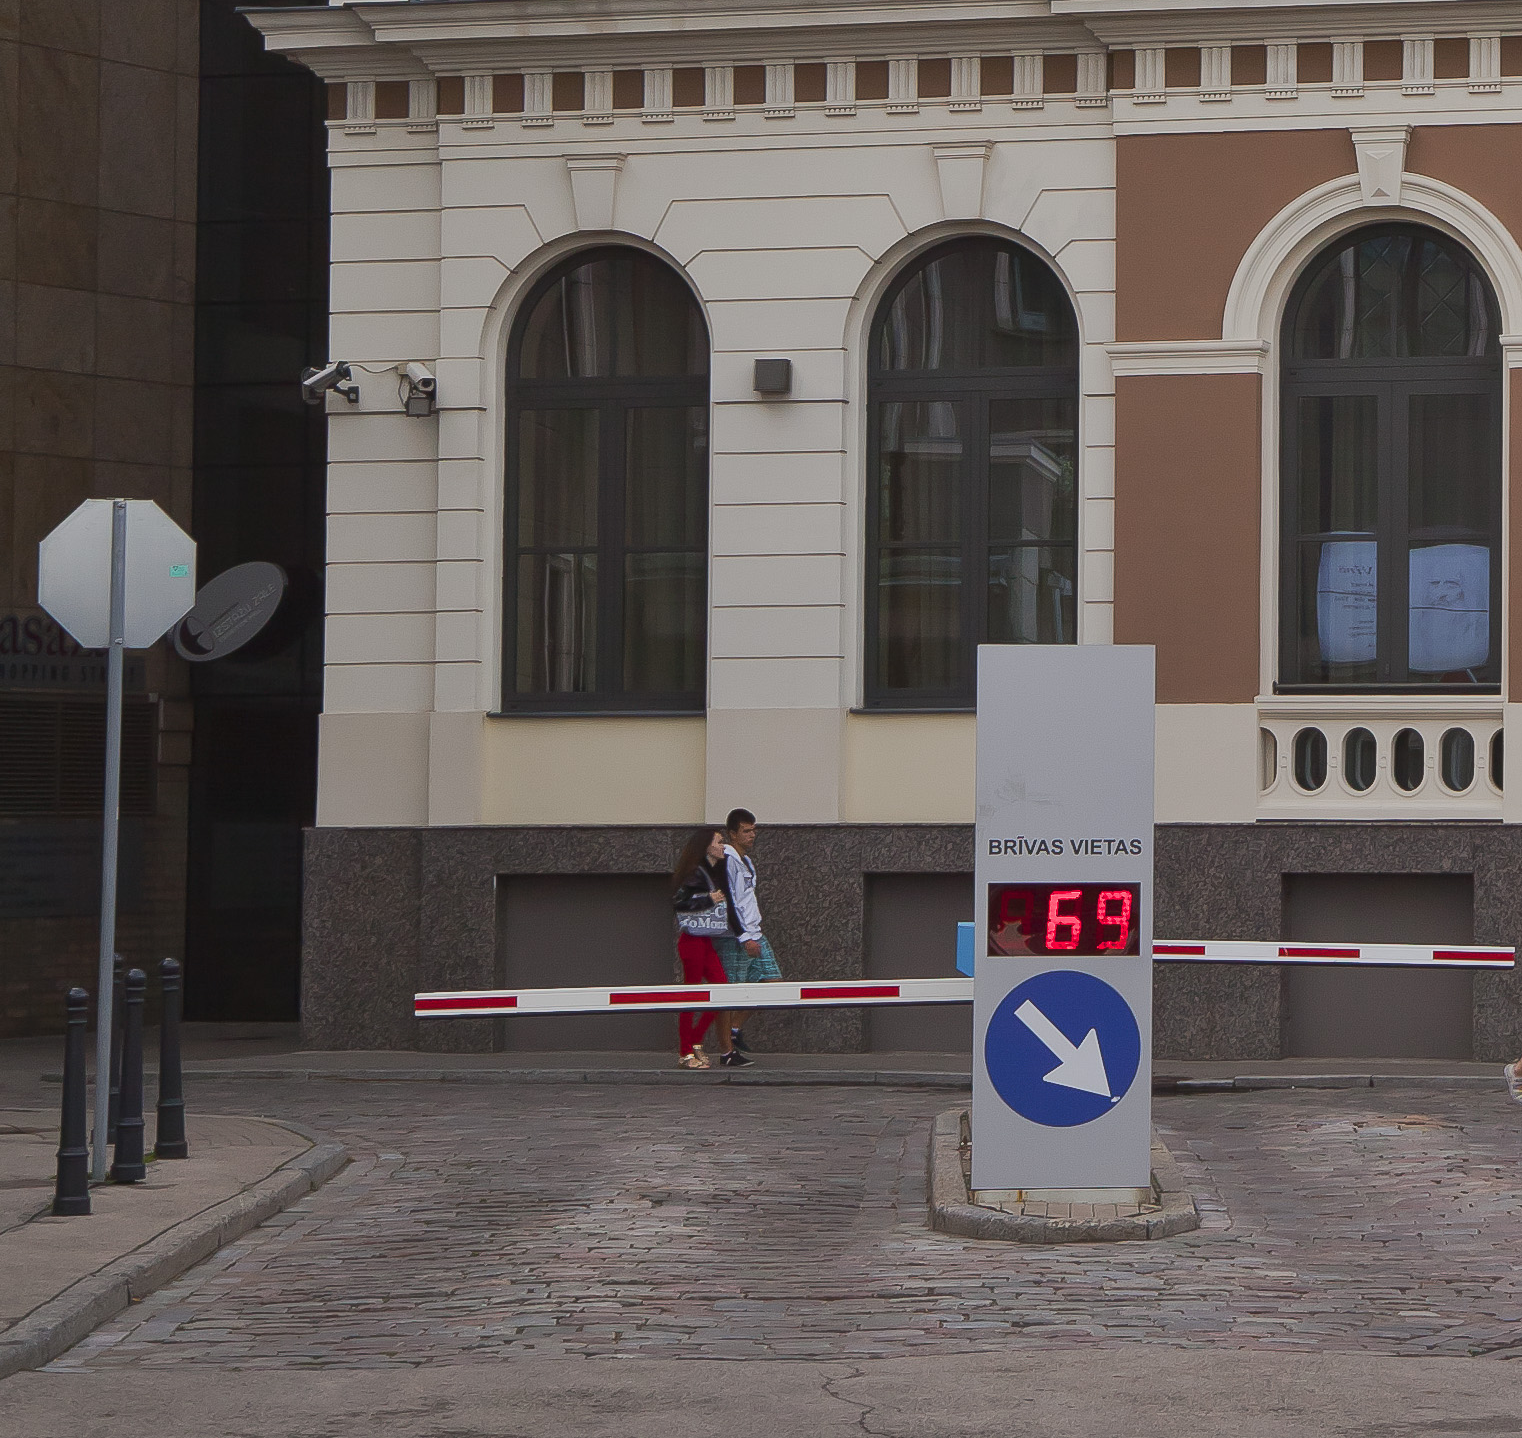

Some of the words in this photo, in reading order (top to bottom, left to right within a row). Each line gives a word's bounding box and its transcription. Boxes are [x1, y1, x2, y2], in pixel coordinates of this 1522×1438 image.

[988, 835, 1064, 855] BRĪVAS
[1070, 839, 1142, 855] VIETAS
[1045, 889, 1133, 950] 69
